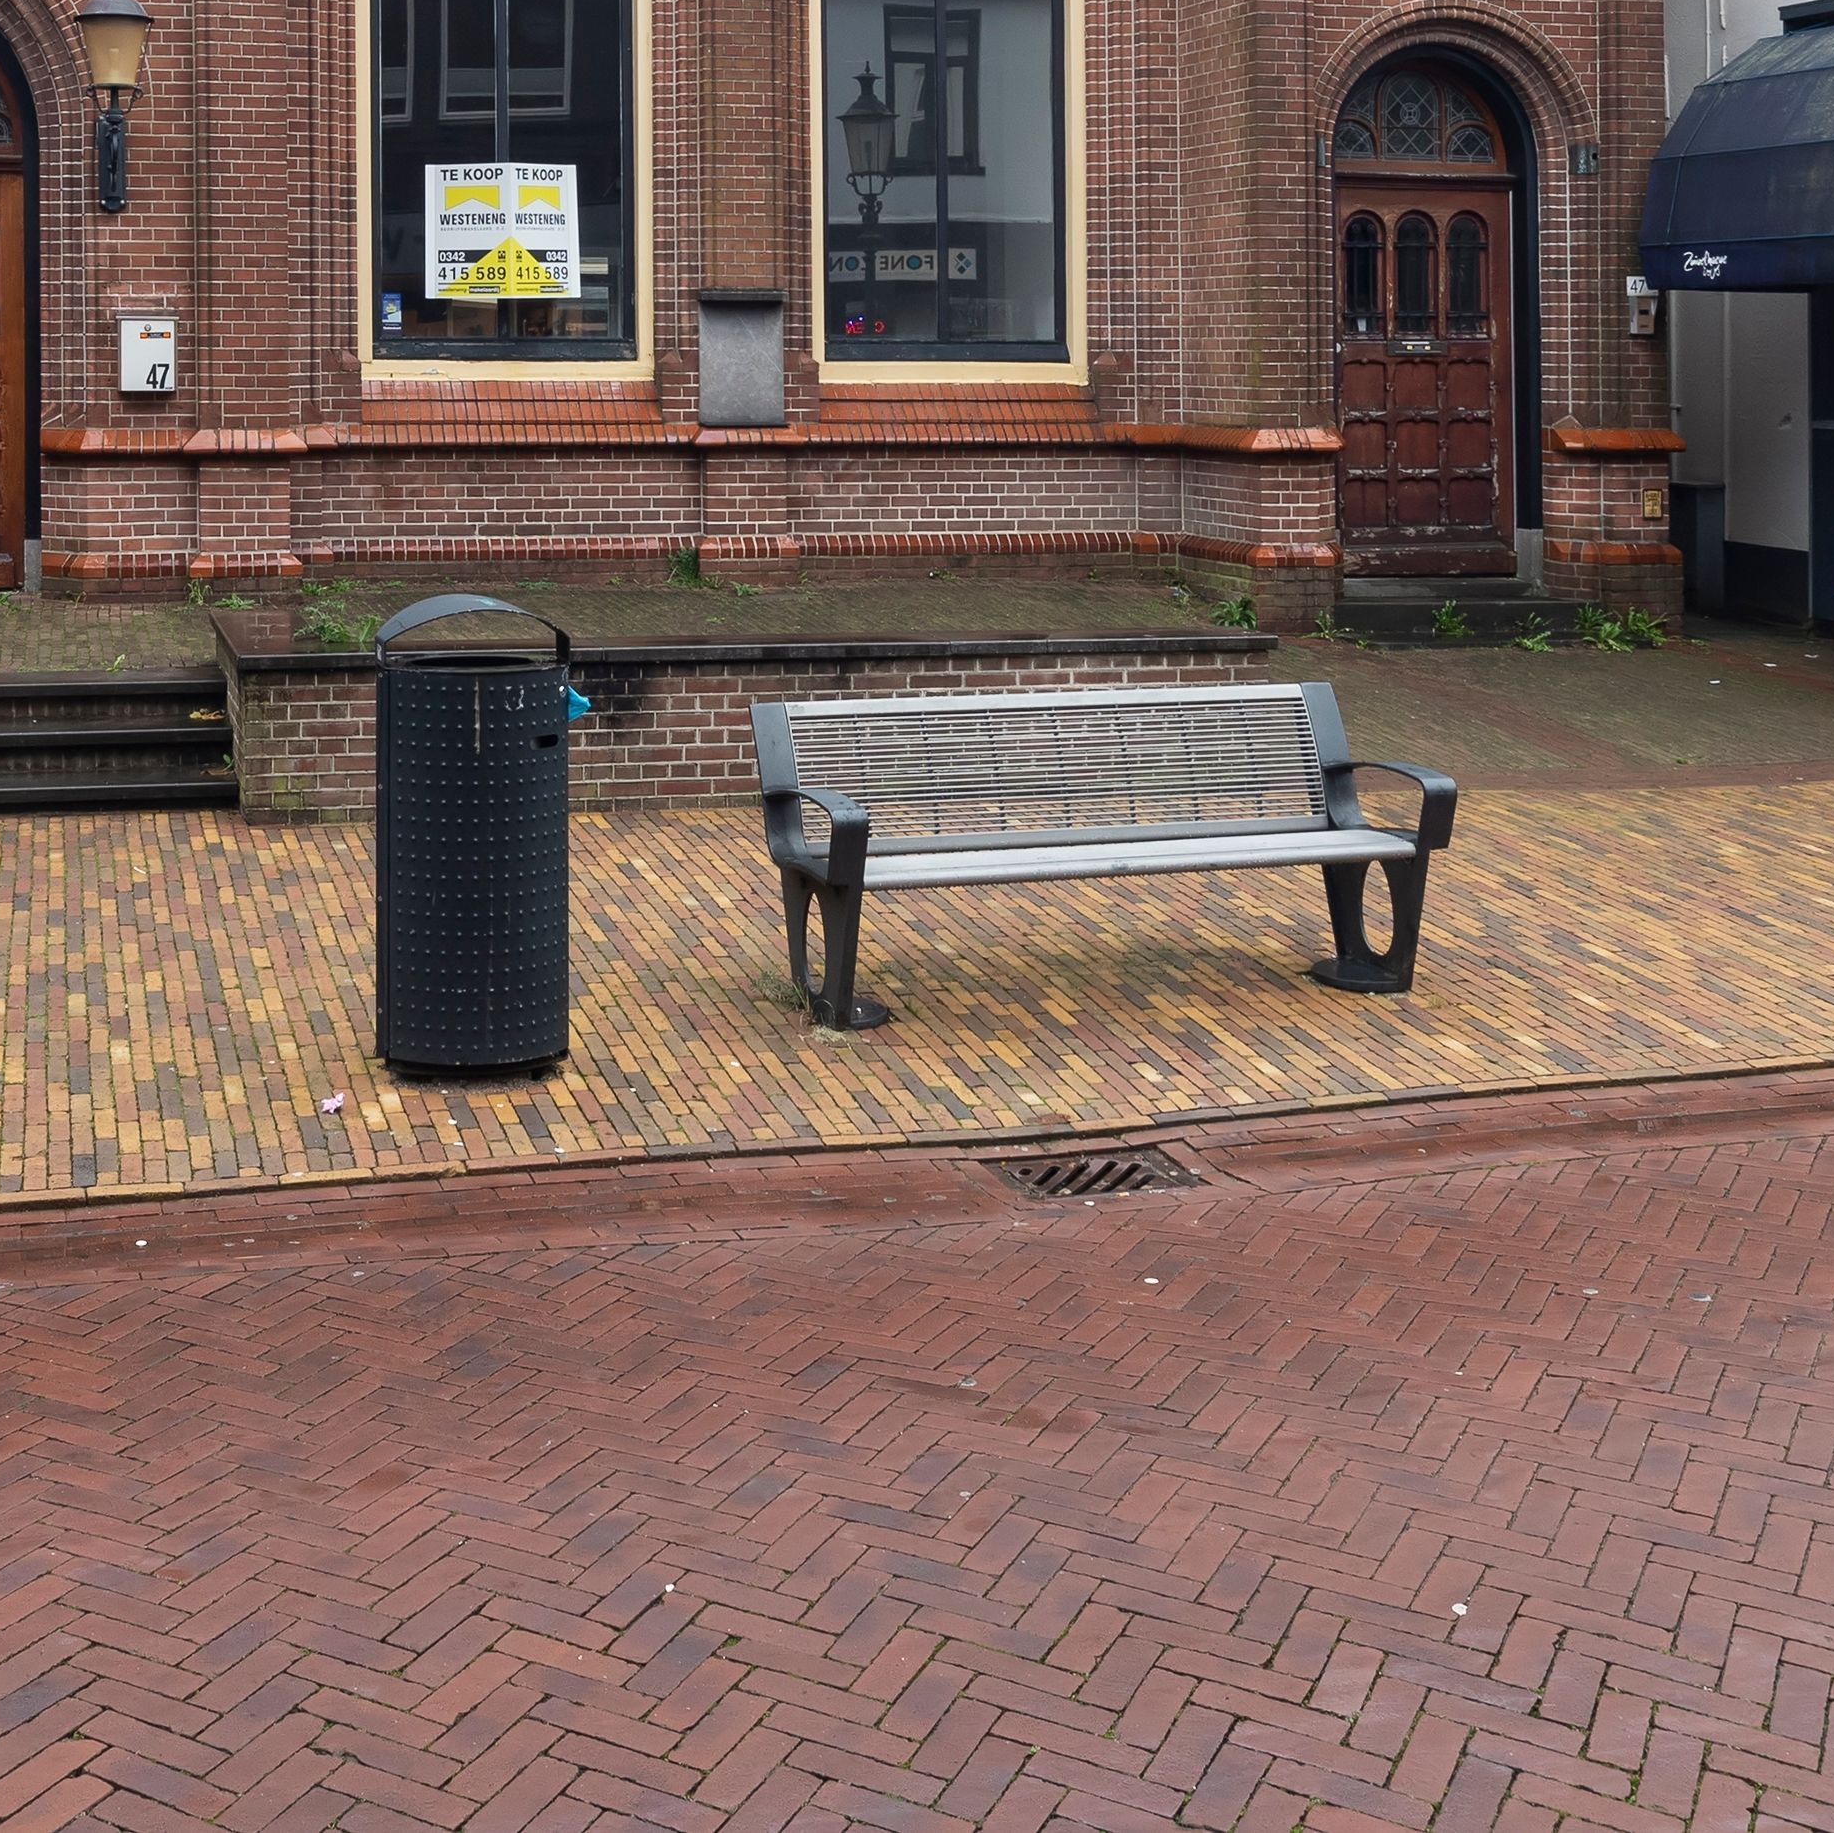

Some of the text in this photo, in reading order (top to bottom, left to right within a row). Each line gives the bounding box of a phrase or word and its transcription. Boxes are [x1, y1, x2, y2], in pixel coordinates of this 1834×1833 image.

[440, 168, 504, 181] TE KOOP
[515, 168, 563, 181] TE KOOP
[439, 213, 506, 225] WESTENENG
[515, 213, 566, 225] WESTENENG
[439, 251, 466, 262] 0342
[545, 251, 567, 261] 0342
[438, 266, 507, 281] 415 589
[516, 266, 569, 280] 415 589
[1630, 279, 1645, 294] 47
[145, 363, 170, 389] 47
